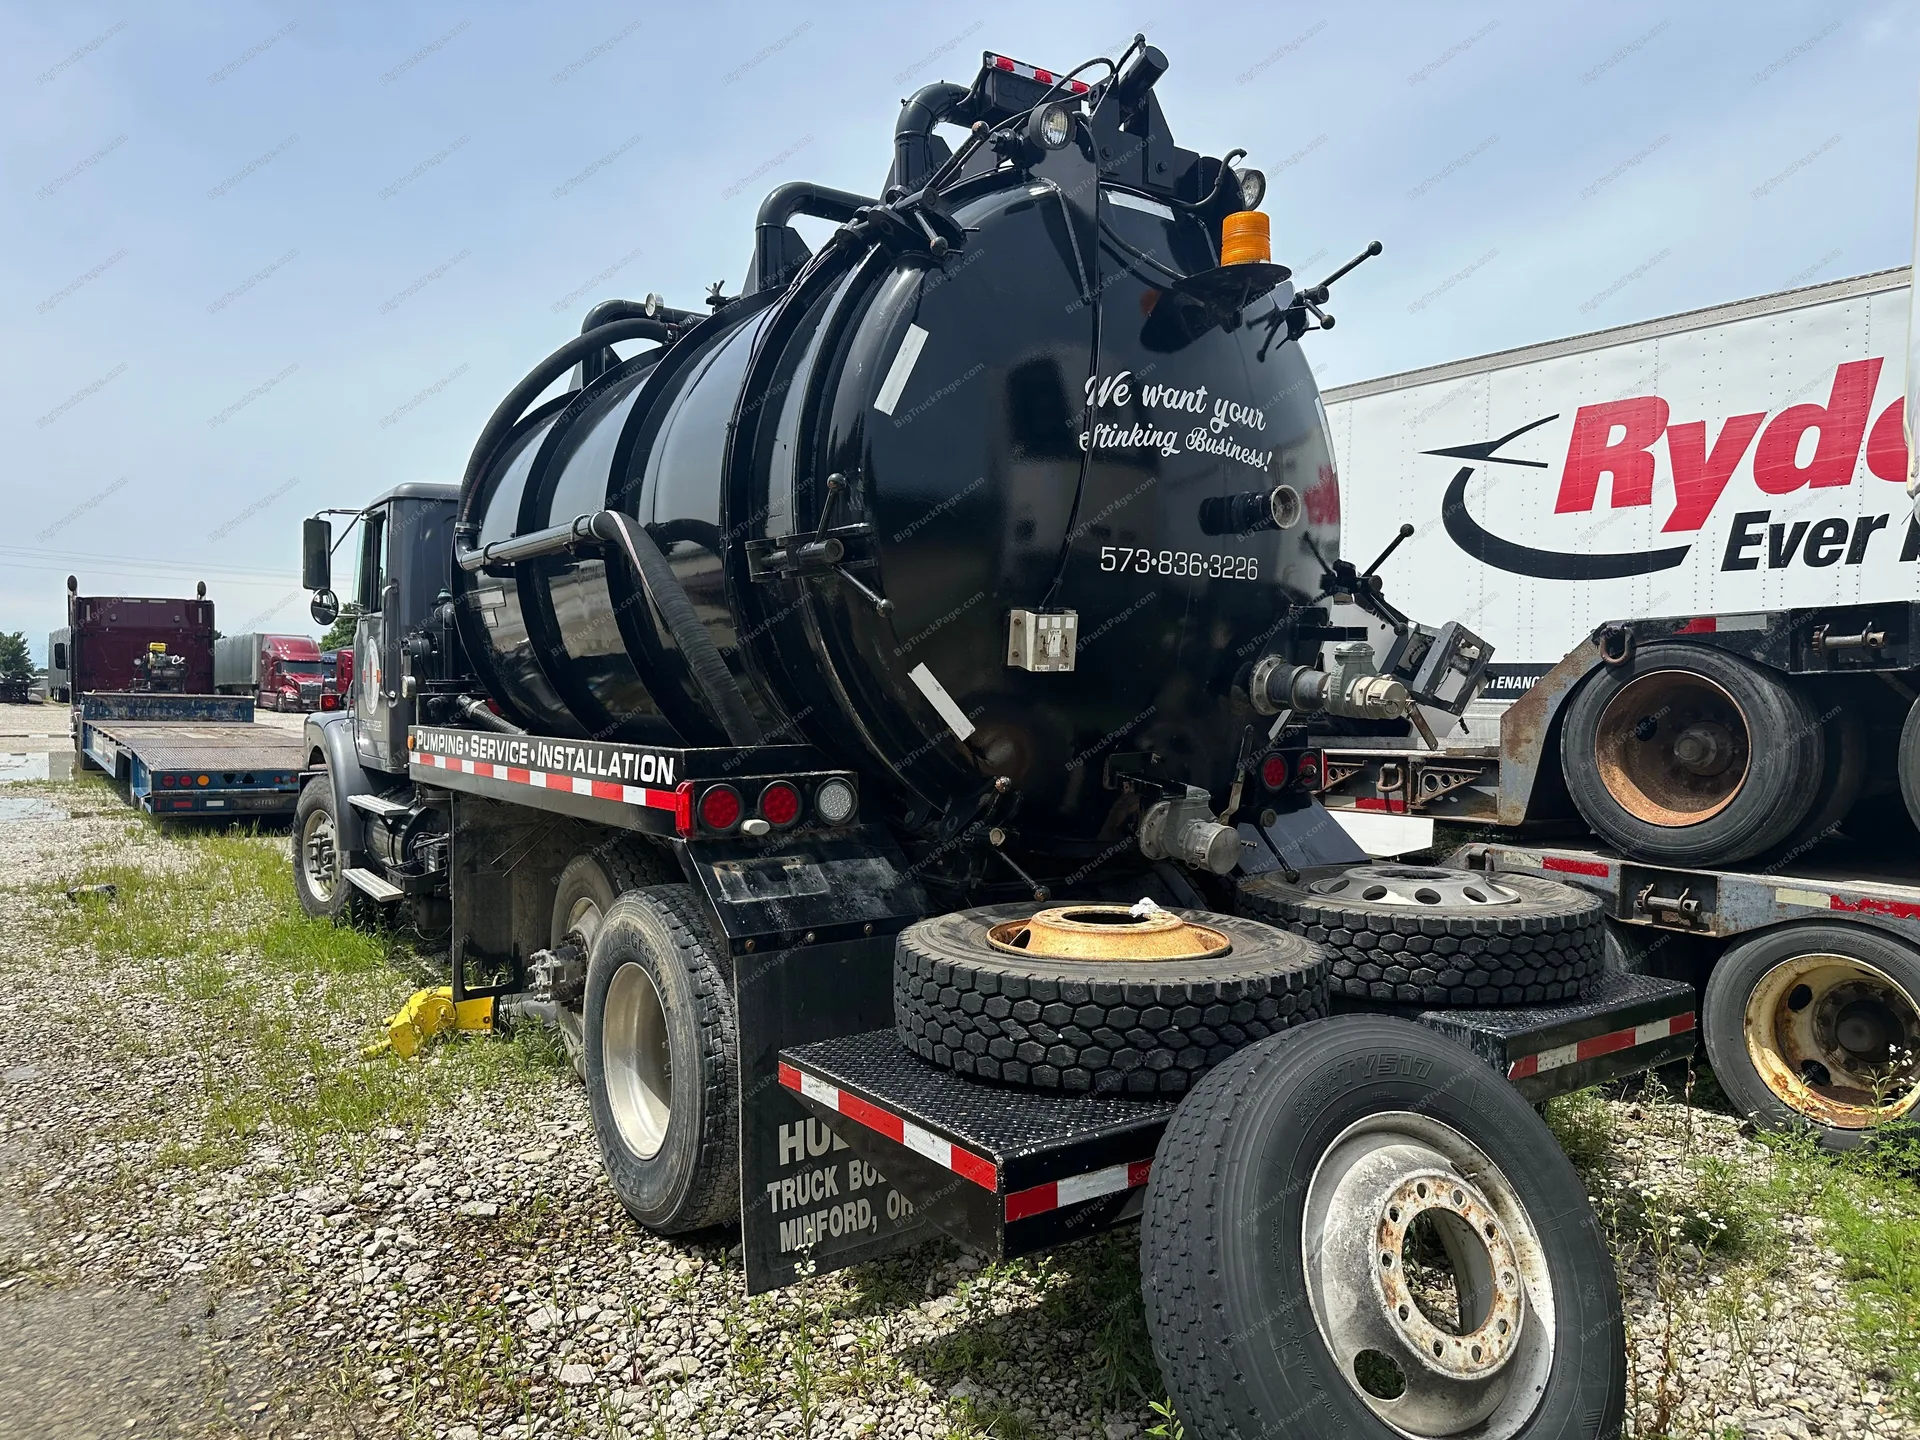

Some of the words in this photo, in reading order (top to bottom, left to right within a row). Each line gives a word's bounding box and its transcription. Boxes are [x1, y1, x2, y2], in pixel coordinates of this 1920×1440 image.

[1084, 370, 1132, 408] We
[1142, 383, 1208, 413] want
[1209, 398, 1267, 434] your
[1079, 422, 1180, 457] Stinking
[1185, 427, 1272, 472] Business!
[1720, 510, 1890, 572] Ever
[779, 1117, 850, 1166] HU
[766, 1164, 840, 1213] TRUCK
[849, 1159, 888, 1191] BO
[779, 1198, 878, 1253] MINFORD,
